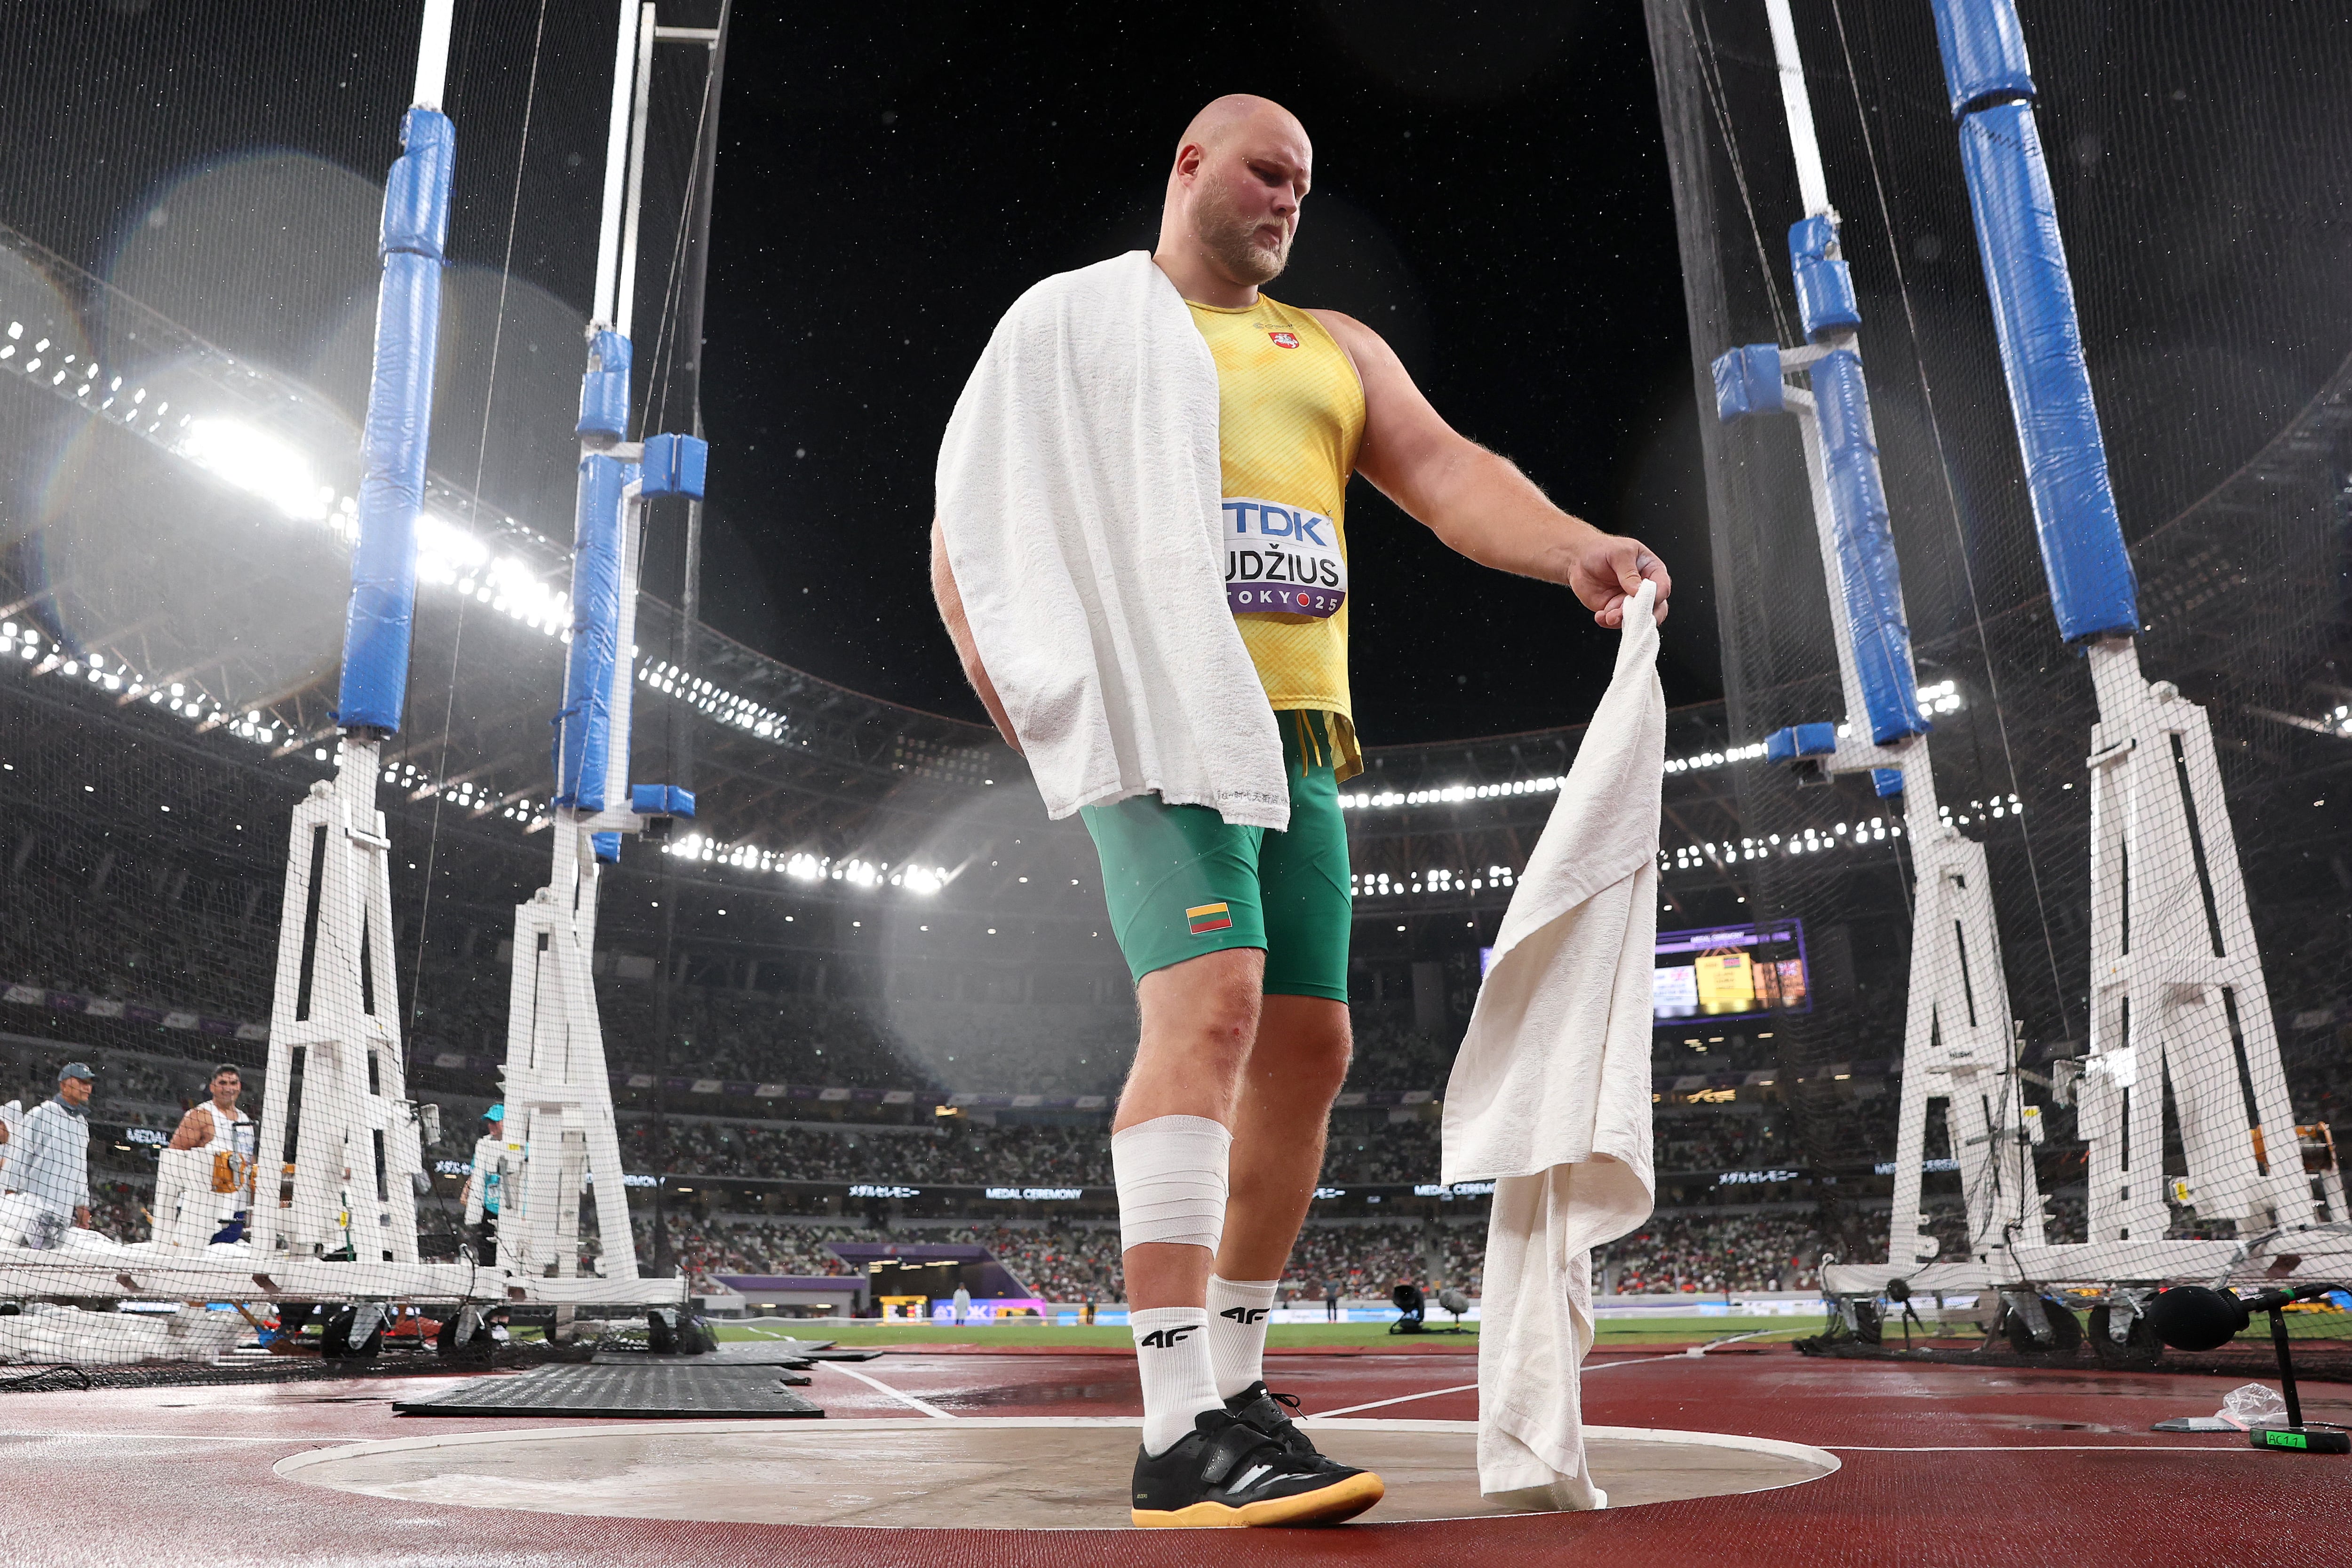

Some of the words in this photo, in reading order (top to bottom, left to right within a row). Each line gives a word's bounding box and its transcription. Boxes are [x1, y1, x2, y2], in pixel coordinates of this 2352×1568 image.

[1222, 502, 1327, 546] TDK
[986, 1188, 1023, 1200] MEDAL
[1023, 1188, 1082, 1200] CEREMONY
[1220, 1307, 1271, 1324] 4F
[1141, 1325, 1199, 1348] 4F
